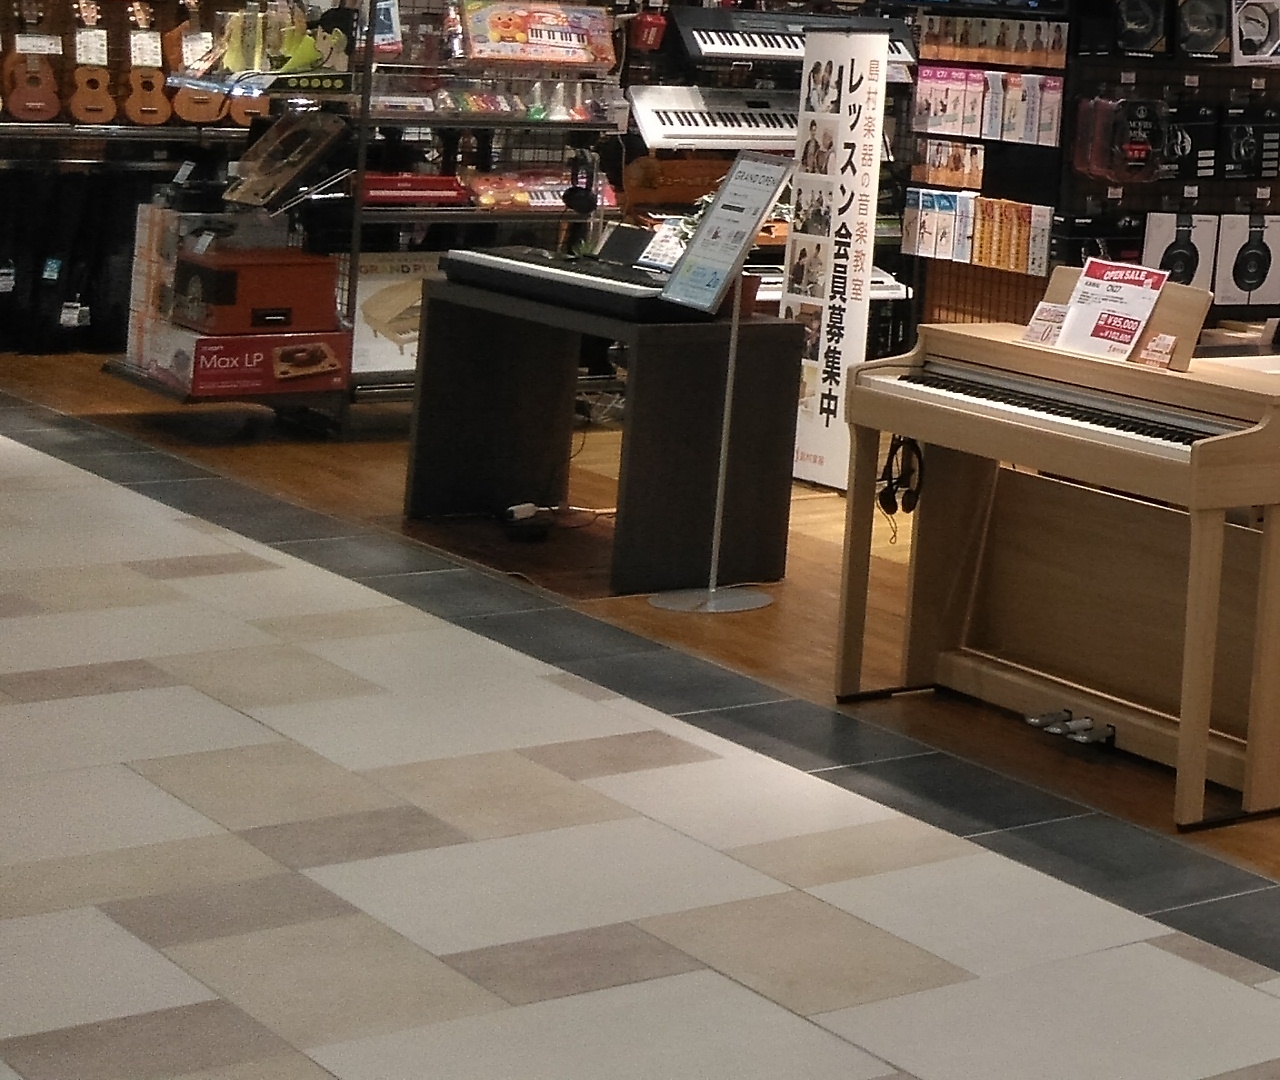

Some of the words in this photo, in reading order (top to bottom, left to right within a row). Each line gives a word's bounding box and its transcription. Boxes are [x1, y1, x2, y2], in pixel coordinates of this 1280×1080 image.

[819, 58, 864, 428] レッスン会員募集中
[850, 59, 880, 303] 島村楽器の音楽教室
[1103, 270, 1124, 281] OPEN
[1124, 270, 1148, 281] SALE
[1107, 316, 1139, 331] ¥95,000
